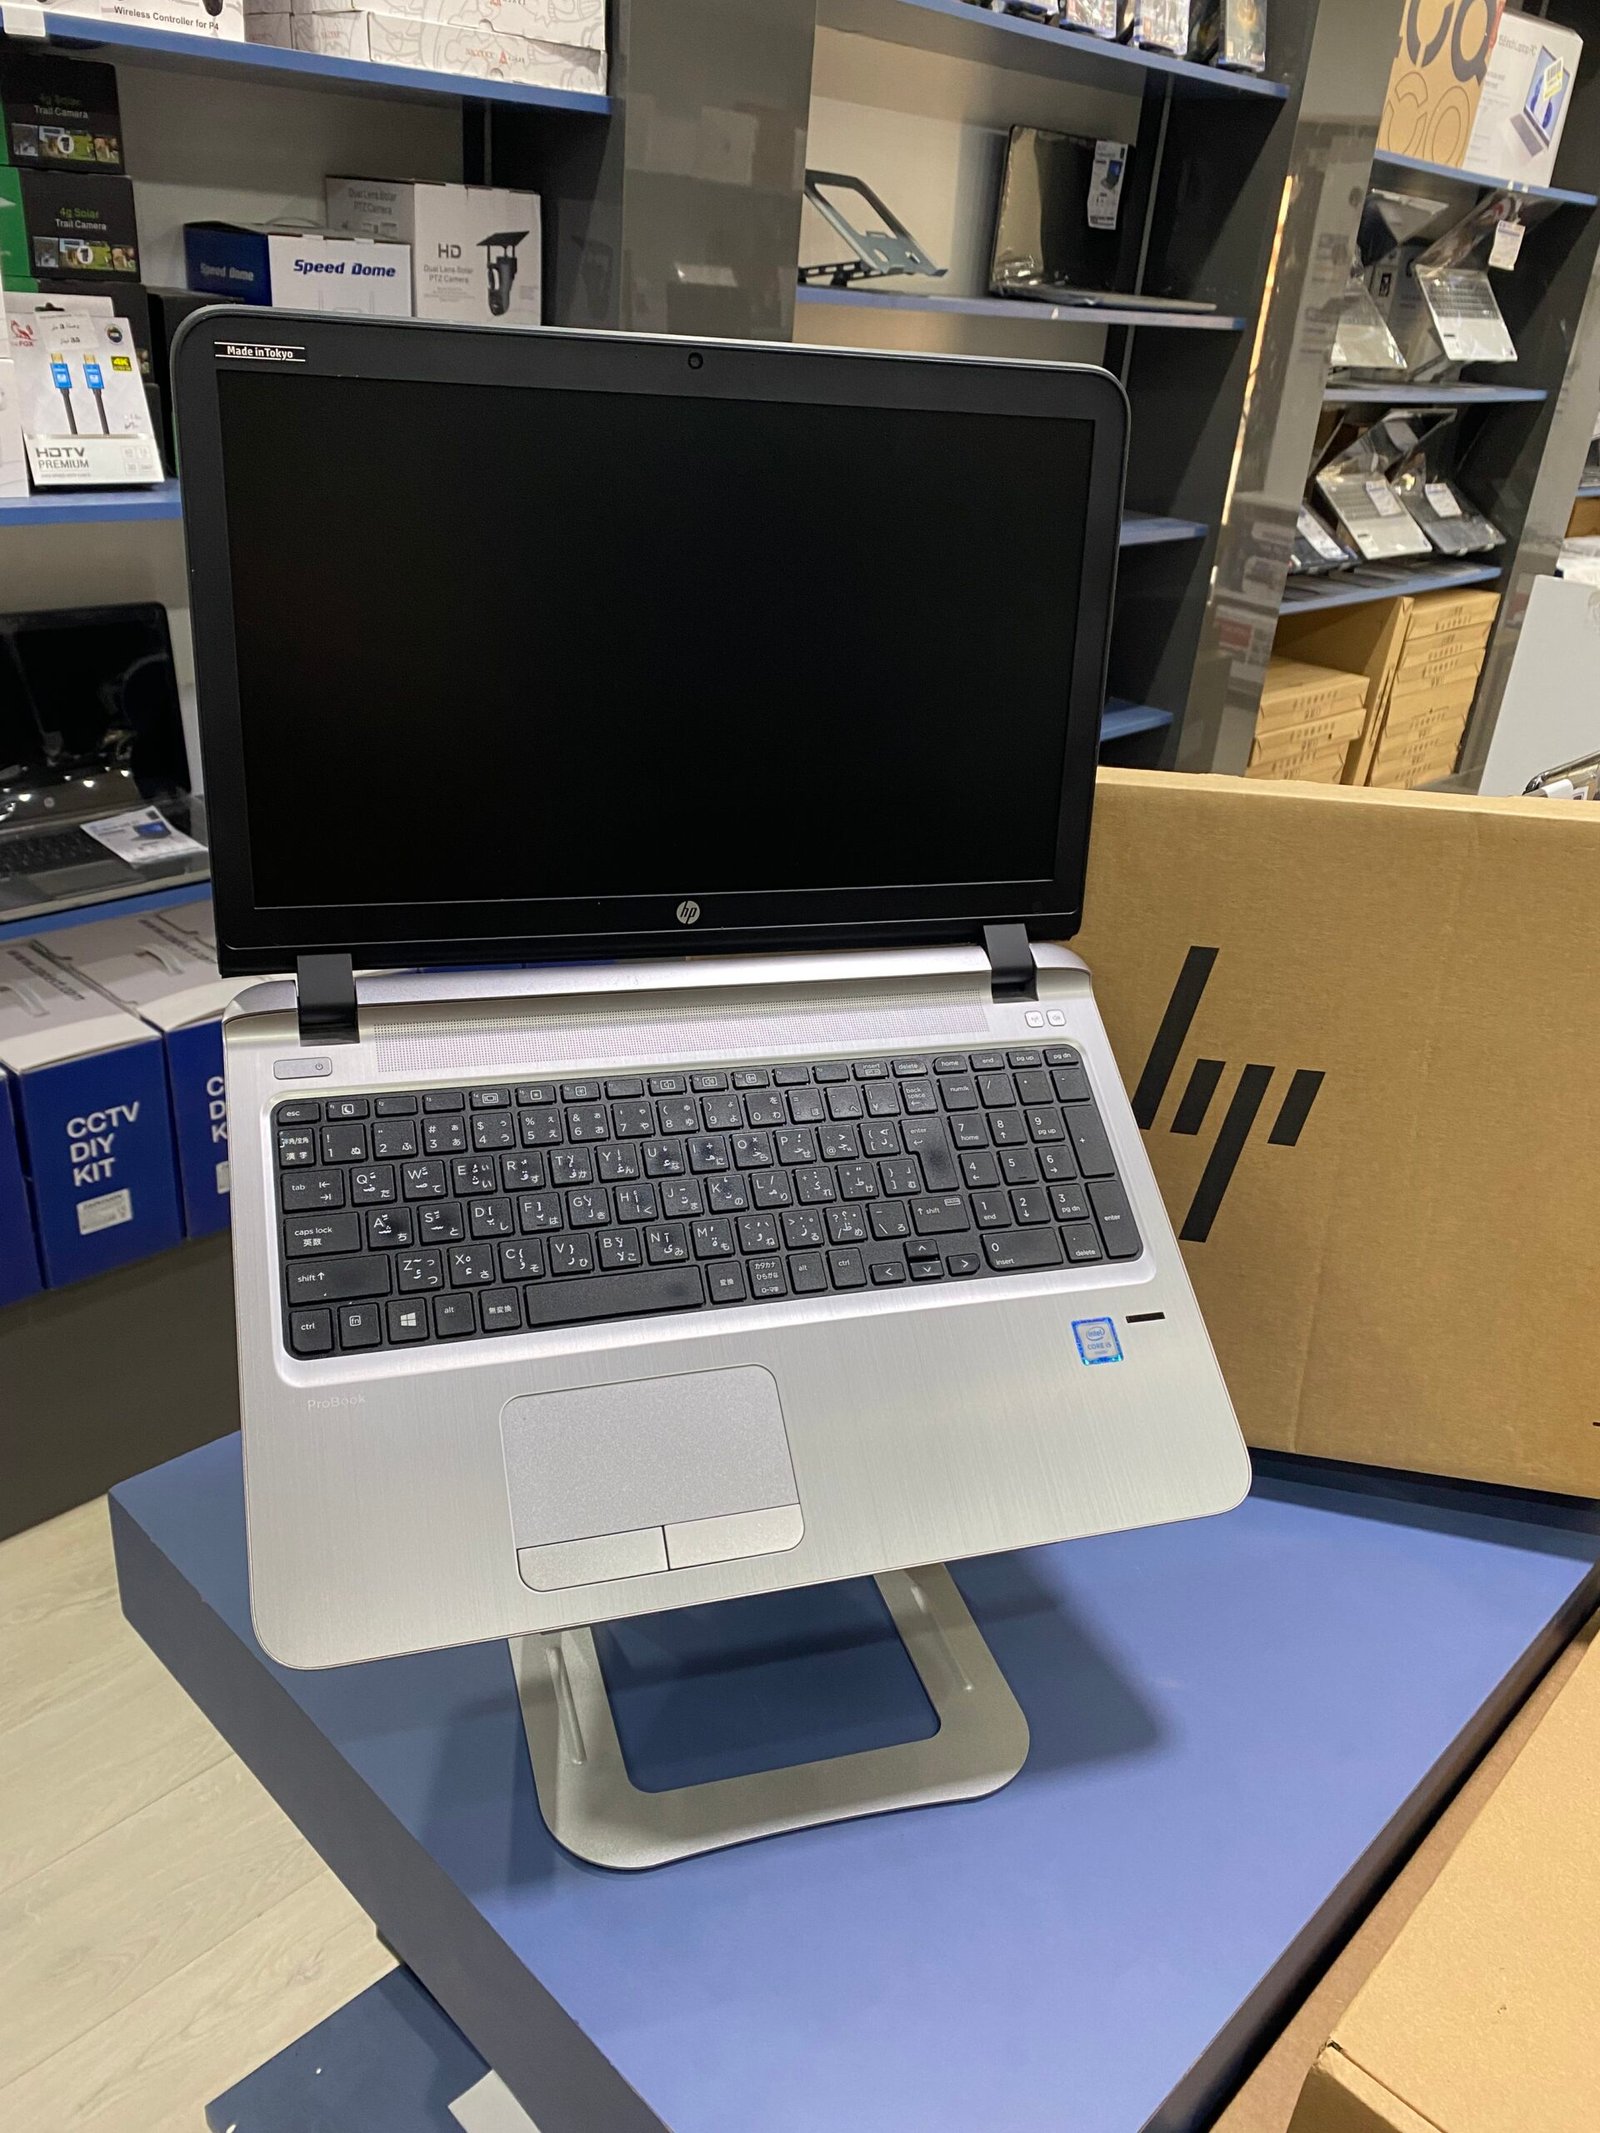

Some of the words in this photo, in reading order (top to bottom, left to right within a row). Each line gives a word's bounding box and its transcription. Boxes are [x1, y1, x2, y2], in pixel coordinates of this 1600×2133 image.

[114, 6, 150, 20] Wireless
[152, 12, 194, 28] Controller
[196, 18, 208, 28] for
[209, 21, 219, 30] P4
[34, 105, 53, 116] Trail
[54, 107, 88, 119] Camera
[60, 207, 72, 218] 4g
[75, 208, 99, 218] Solar
[55, 218, 73, 228] Trail
[74, 220, 107, 231] Camera
[437, 242, 461, 259] HD
[200, 261, 226, 279] Speed
[229, 264, 254, 281] Dome
[294, 258, 345, 275] Speed
[352, 261, 396, 277] Dome
[444, 275, 469, 285] Camera
[227, 346, 253, 356] Made
[113, 358, 128, 366] 4K
[36, 447, 85, 458] HDTV
[39, 460, 89, 469] PREMIUM
[679, 900, 698, 924] hp
[67, 1101, 140, 1139] CCTV
[525, 1117, 535, 1126] %
[573, 1114, 580, 1122] &
[710, 1115, 717, 1124] 9
[1035, 1117, 1042, 1126] 9
[477, 1122, 484, 1130] $
[666, 1120, 673, 1128] 8
[958, 1124, 964, 1132] 7
[997, 1120, 1004, 1129] 8
[528, 1131, 535, 1139] 5
[574, 1127, 582, 1136] 6
[479, 1135, 486, 1143] 4
[781, 1136, 788, 1146] P
[69, 1134, 116, 1163] DIY
[379, 1144, 387, 1153] 2
[430, 1140, 437, 1148] 3
[328, 1149, 333, 1157] 1
[648, 1148, 656, 1157] U
[826, 1146, 836, 1155] @
[555, 1156, 563, 1165] T
[602, 1152, 611, 1161] Y
[1046, 1155, 1054, 1164] 6
[507, 1161, 516, 1170] R
[969, 1162, 977, 1170] 4
[1008, 1159, 1015, 1167] 5
[73, 1157, 116, 1187] KIT
[408, 1170, 422, 1179] W
[458, 1165, 466, 1175] E
[357, 1175, 368, 1184] Q
[292, 1183, 306, 1191] tab
[712, 1184, 720, 1193] K
[756, 1180, 764, 1189] L
[668, 1188, 674, 1197] J
[573, 1198, 582, 1206] G
[620, 1193, 629, 1202] H
[1058, 1194, 1066, 1202] 3
[981, 1202, 987, 1210] 1
[1020, 1198, 1027, 1207] 2
[525, 1203, 532, 1212] F
[475, 1208, 484, 1217] D
[374, 1218, 384, 1227] A
[424, 1213, 433, 1223] S
[697, 1228, 707, 1237] M
[651, 1233, 660, 1242] N
[603, 1238, 612, 1248] B
[991, 1243, 1000, 1252] 0
[555, 1243, 565, 1253] V
[506, 1249, 515, 1259] C
[455, 1255, 464, 1264] X
[996, 1258, 1014, 1266] insert
[403, 1260, 413, 1270] Z
[298, 1274, 316, 1282] shift
[307, 1394, 366, 1411] ProBook
